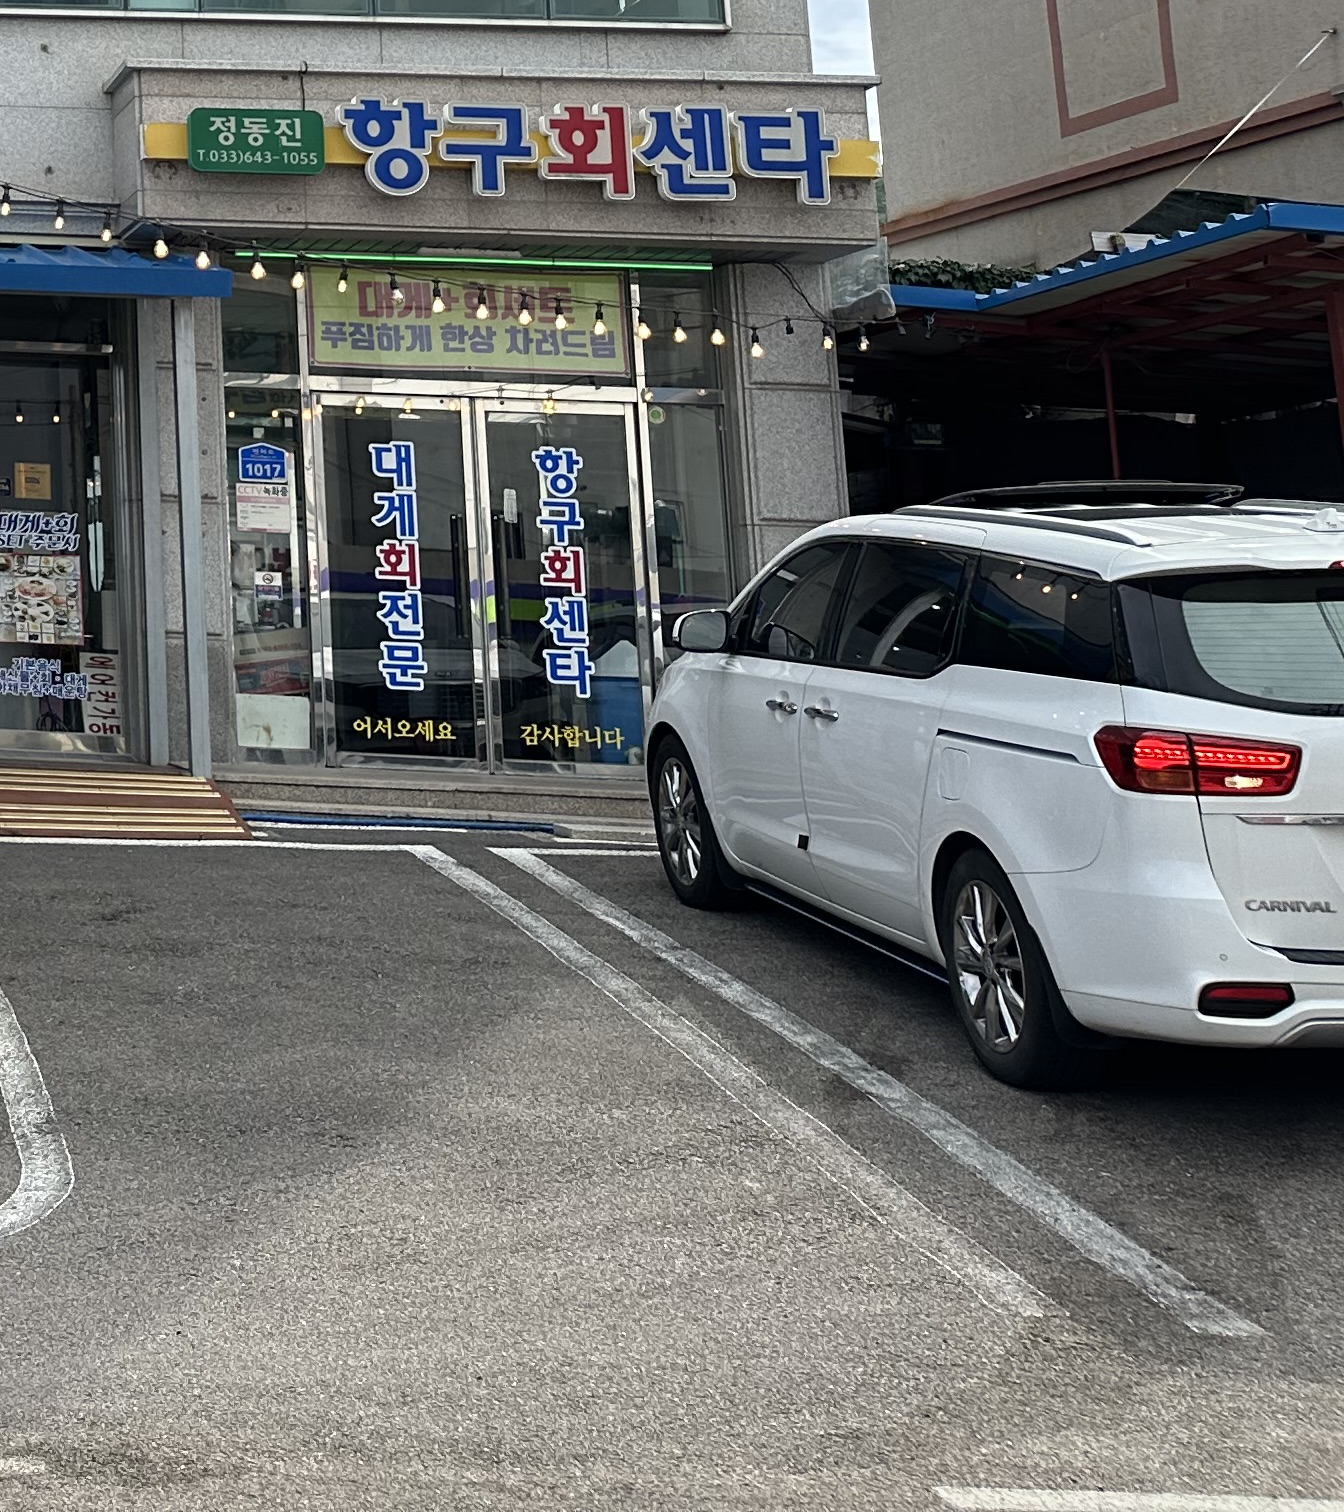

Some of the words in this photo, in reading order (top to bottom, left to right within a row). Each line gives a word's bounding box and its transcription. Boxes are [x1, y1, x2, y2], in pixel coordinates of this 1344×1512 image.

[209, 116, 302, 147] 정동진
[343, 99, 834, 201] 항구회센타
[321, 321, 433, 353] 푸짐하게
[439, 322, 497, 354] 한상
[504, 326, 617, 359] 차려드림
[245, 463, 281, 477] 1017
[237, 486, 262, 494] CCTV
[369, 441, 427, 690] 대게회전문
[531, 447, 595, 698] 항구회센타
[353, 717, 457, 740] 어서오세요
[519, 723, 625, 750] 감사합니다
[1244, 899, 1338, 913] CARNIVAL
